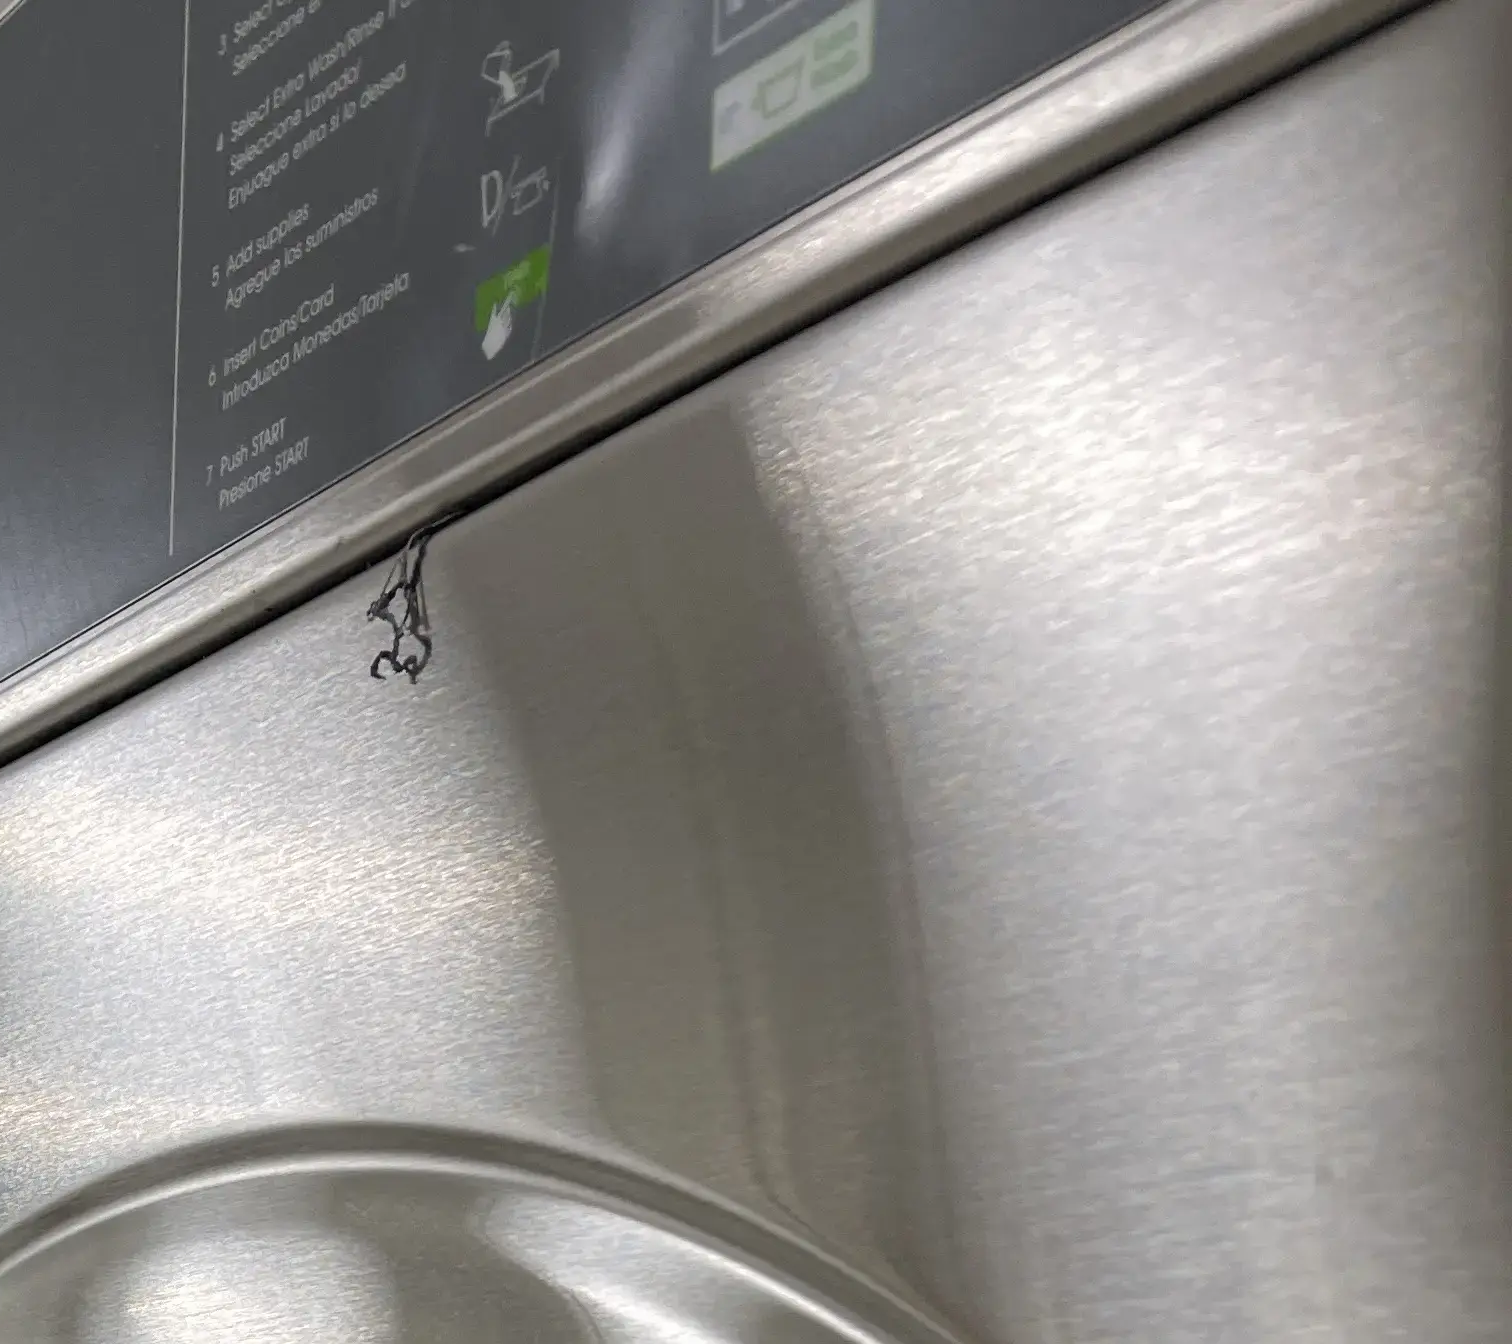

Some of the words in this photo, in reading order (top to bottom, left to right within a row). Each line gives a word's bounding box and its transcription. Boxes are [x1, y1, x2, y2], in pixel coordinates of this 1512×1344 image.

[230, 95, 271, 142] Select
[308, 10, 385, 82] Wash/Rinse
[228, 152, 289, 209] Enjuague
[292, 123, 327, 160] extra
[229, 108, 303, 176] Seleccione
[211, 264, 220, 288] 5
[225, 240, 254, 278] Add
[256, 203, 311, 254] supplies
[225, 258, 281, 311] Agregue
[284, 240, 303, 268] los
[305, 187, 379, 253] suministros
[208, 365, 217, 387] 6
[223, 336, 257, 377] Insert
[259, 283, 335, 351] Coins/Card
[221, 351, 290, 411] Introduzca
[293, 271, 410, 364] Monedas/Tarjeta
[206, 464, 213, 487] 7
[219, 444, 249, 477] Push
[251, 416, 287, 457] START
[219, 465, 271, 511] Presione
[274, 436, 310, 476] START
